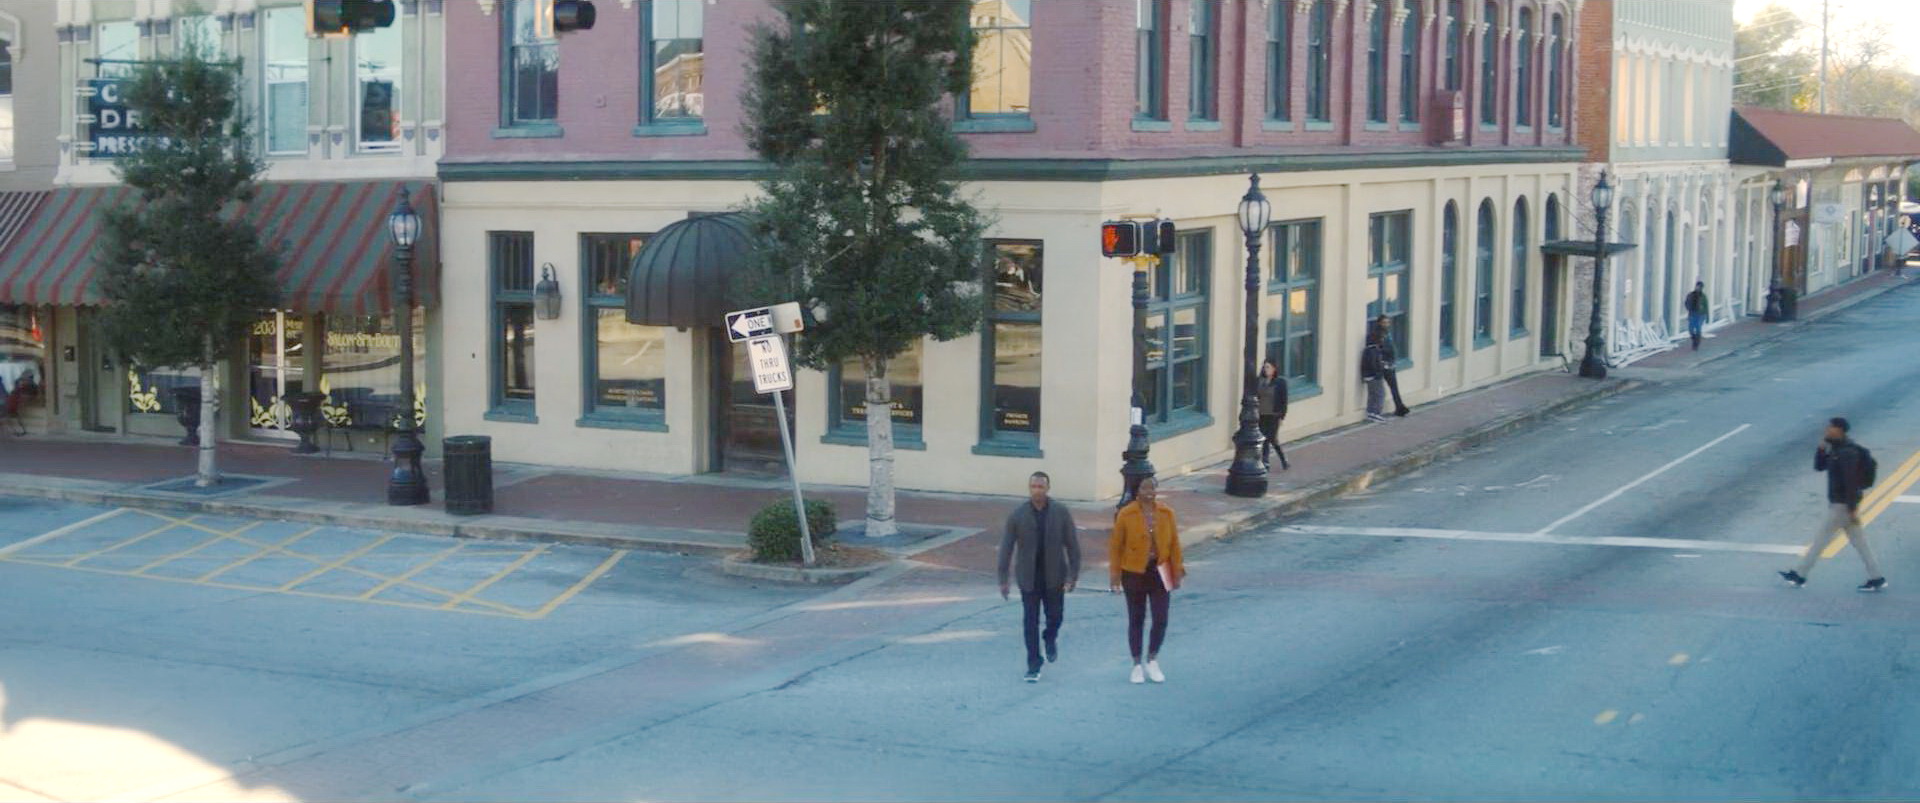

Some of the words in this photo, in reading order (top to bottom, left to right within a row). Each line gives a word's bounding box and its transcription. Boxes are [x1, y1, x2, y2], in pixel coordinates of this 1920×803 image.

[253, 320, 276, 336] 203
[747, 316, 767, 329] ONE
[760, 340, 773, 353] NO
[759, 357, 780, 369] THRU
[758, 371, 787, 385] TRUCKS
